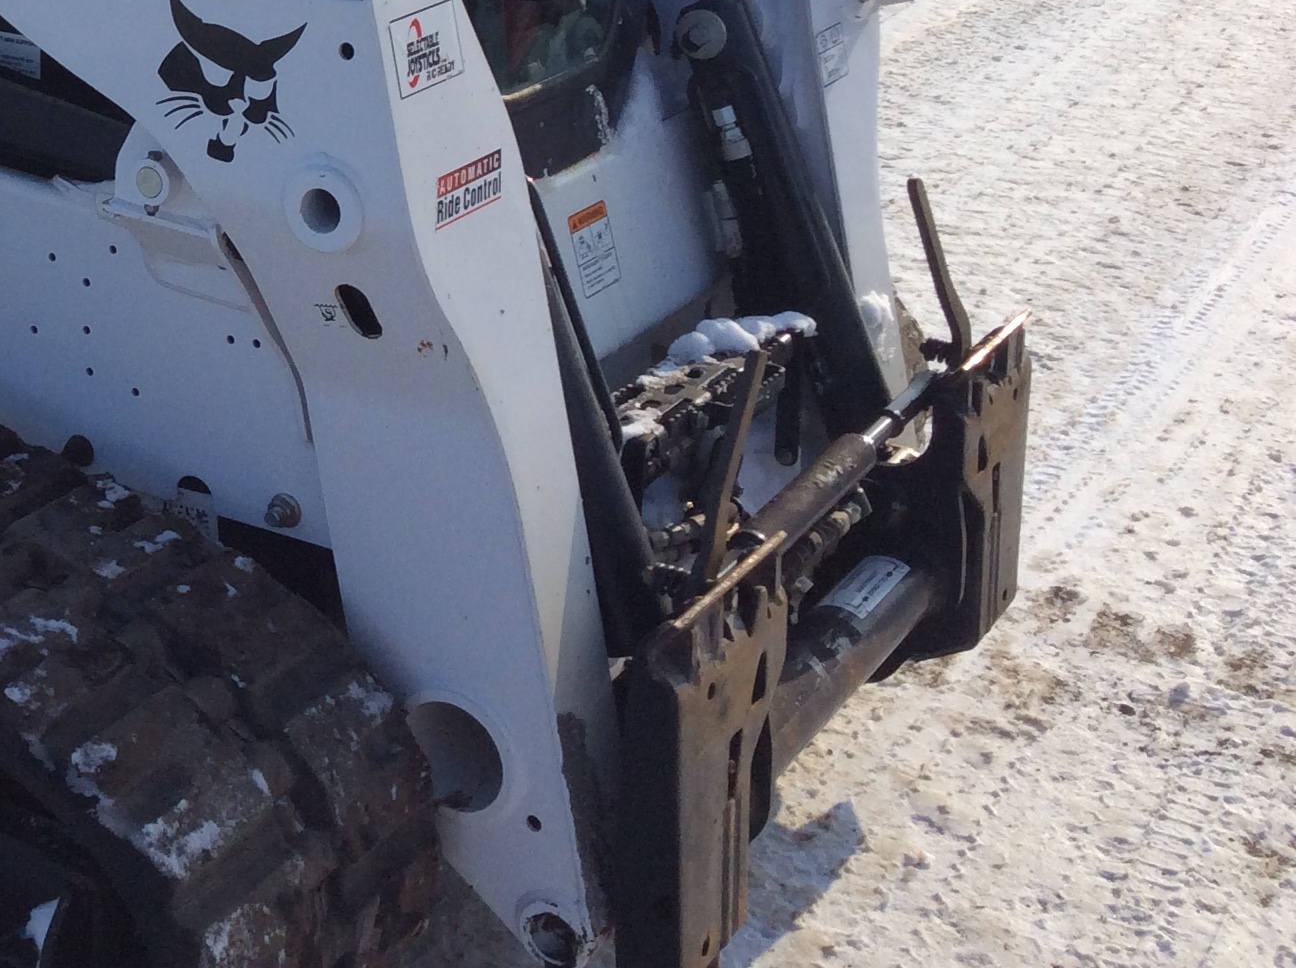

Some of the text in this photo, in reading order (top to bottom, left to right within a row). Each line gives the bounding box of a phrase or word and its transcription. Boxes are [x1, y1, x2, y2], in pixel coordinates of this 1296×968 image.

[437, 170, 502, 224] Ride Control
[439, 153, 501, 195] AUTOMATIC
